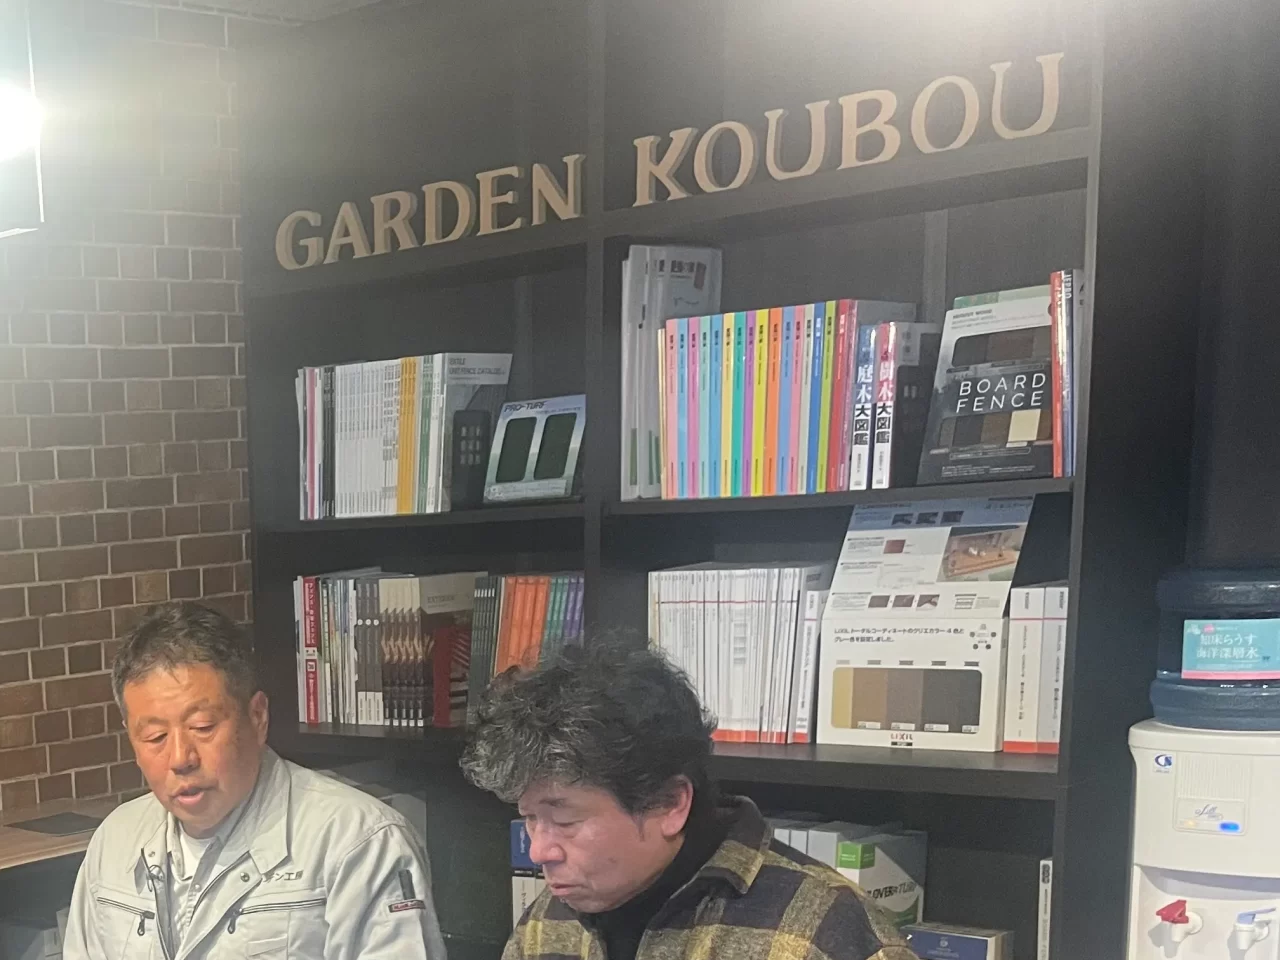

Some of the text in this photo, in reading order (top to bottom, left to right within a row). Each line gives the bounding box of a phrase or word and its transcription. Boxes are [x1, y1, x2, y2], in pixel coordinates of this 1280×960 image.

[274, 52, 1065, 271] GARDEN KOUBOU
[958, 372, 1047, 396] BOARD
[955, 390, 1044, 413] FENCE
[890, 733, 914, 742] LIXIL
